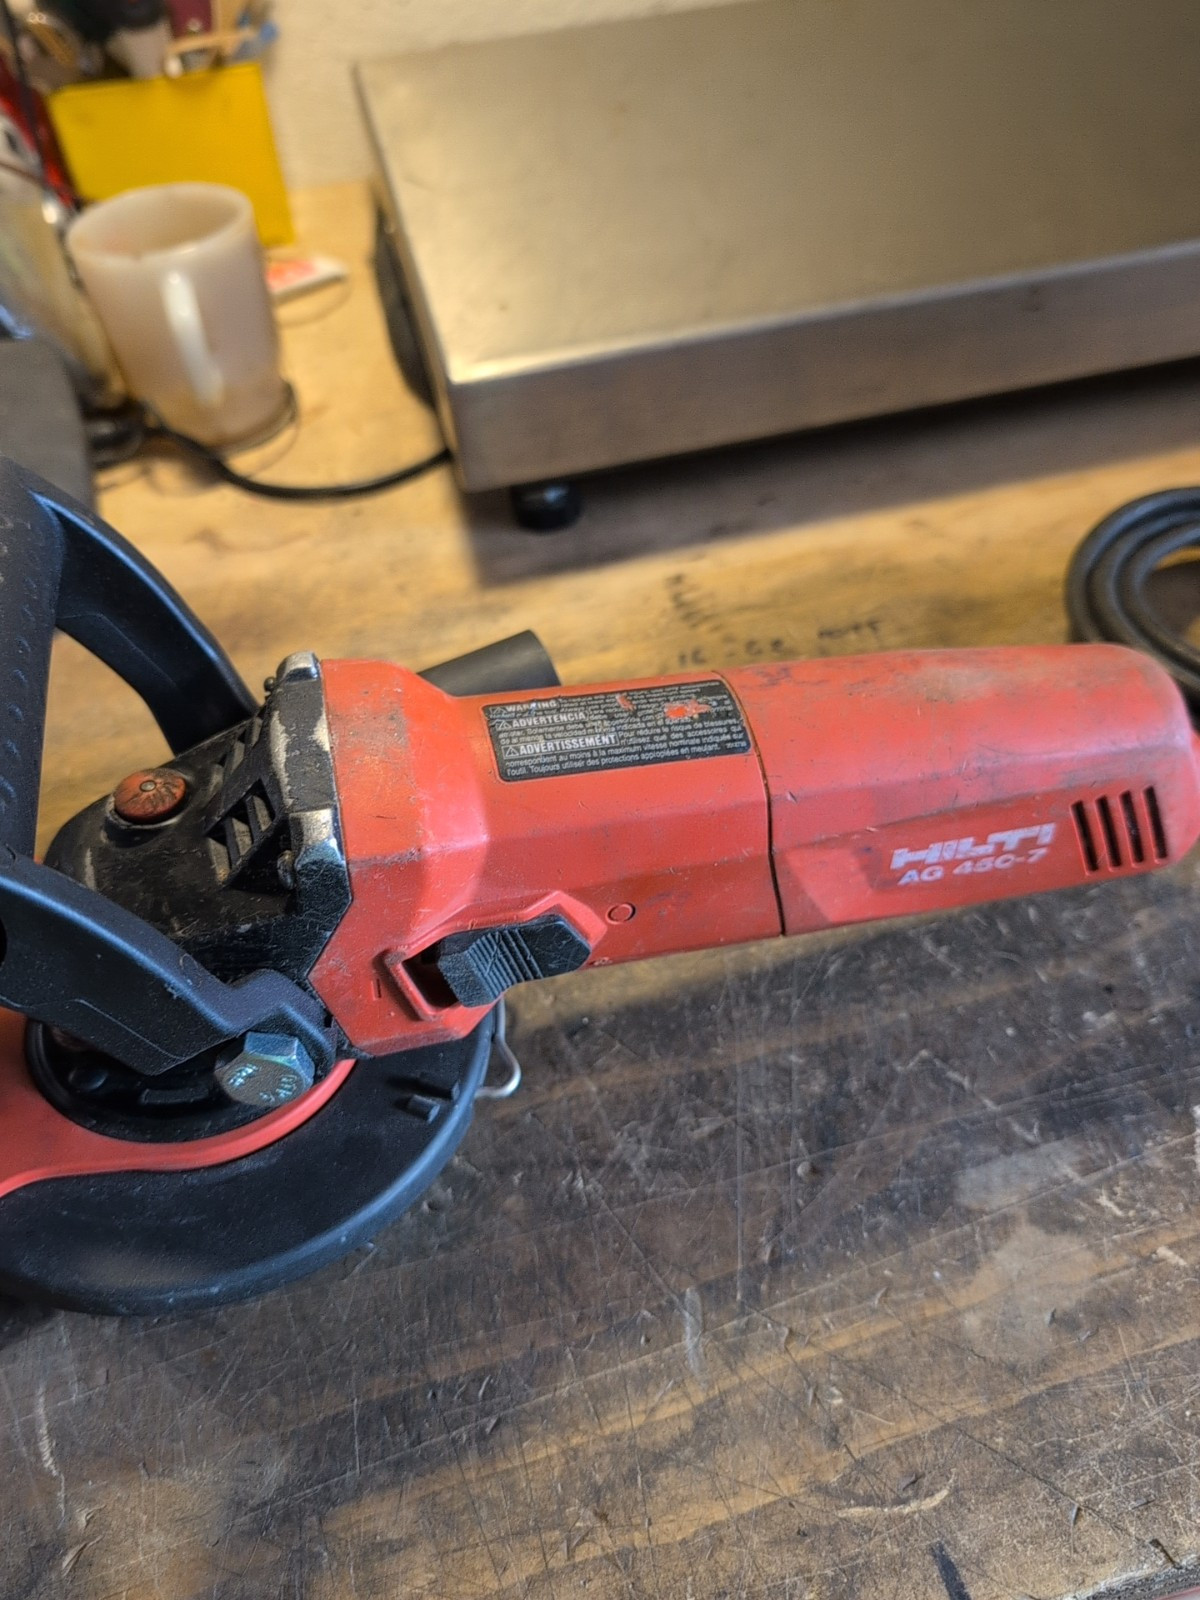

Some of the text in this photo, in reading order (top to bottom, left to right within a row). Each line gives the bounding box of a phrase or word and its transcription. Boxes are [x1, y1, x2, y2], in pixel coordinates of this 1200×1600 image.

[506, 701, 557, 712] WARING
[512, 712, 586, 728] ADVERTENCIA
[519, 735, 616, 755] ADVERTISSEMENT
[619, 730, 635, 738] Pour
[636, 727, 660, 736] réduire
[671, 723, 692, 733] risque
[671, 732, 683, 740] des
[687, 727, 727, 738] accessoires
[570, 751, 591, 760] moins
[608, 745, 641, 756] maximum
[644, 742, 668, 751] vitesse
[669, 738, 700, 748] nominale
[531, 763, 560, 774] Toujours
[587, 758, 599, 766] des
[602, 753, 639, 766] protections
[890, 821, 1056, 870] HILTI
[898, 847, 1048, 886] AG 450-7
